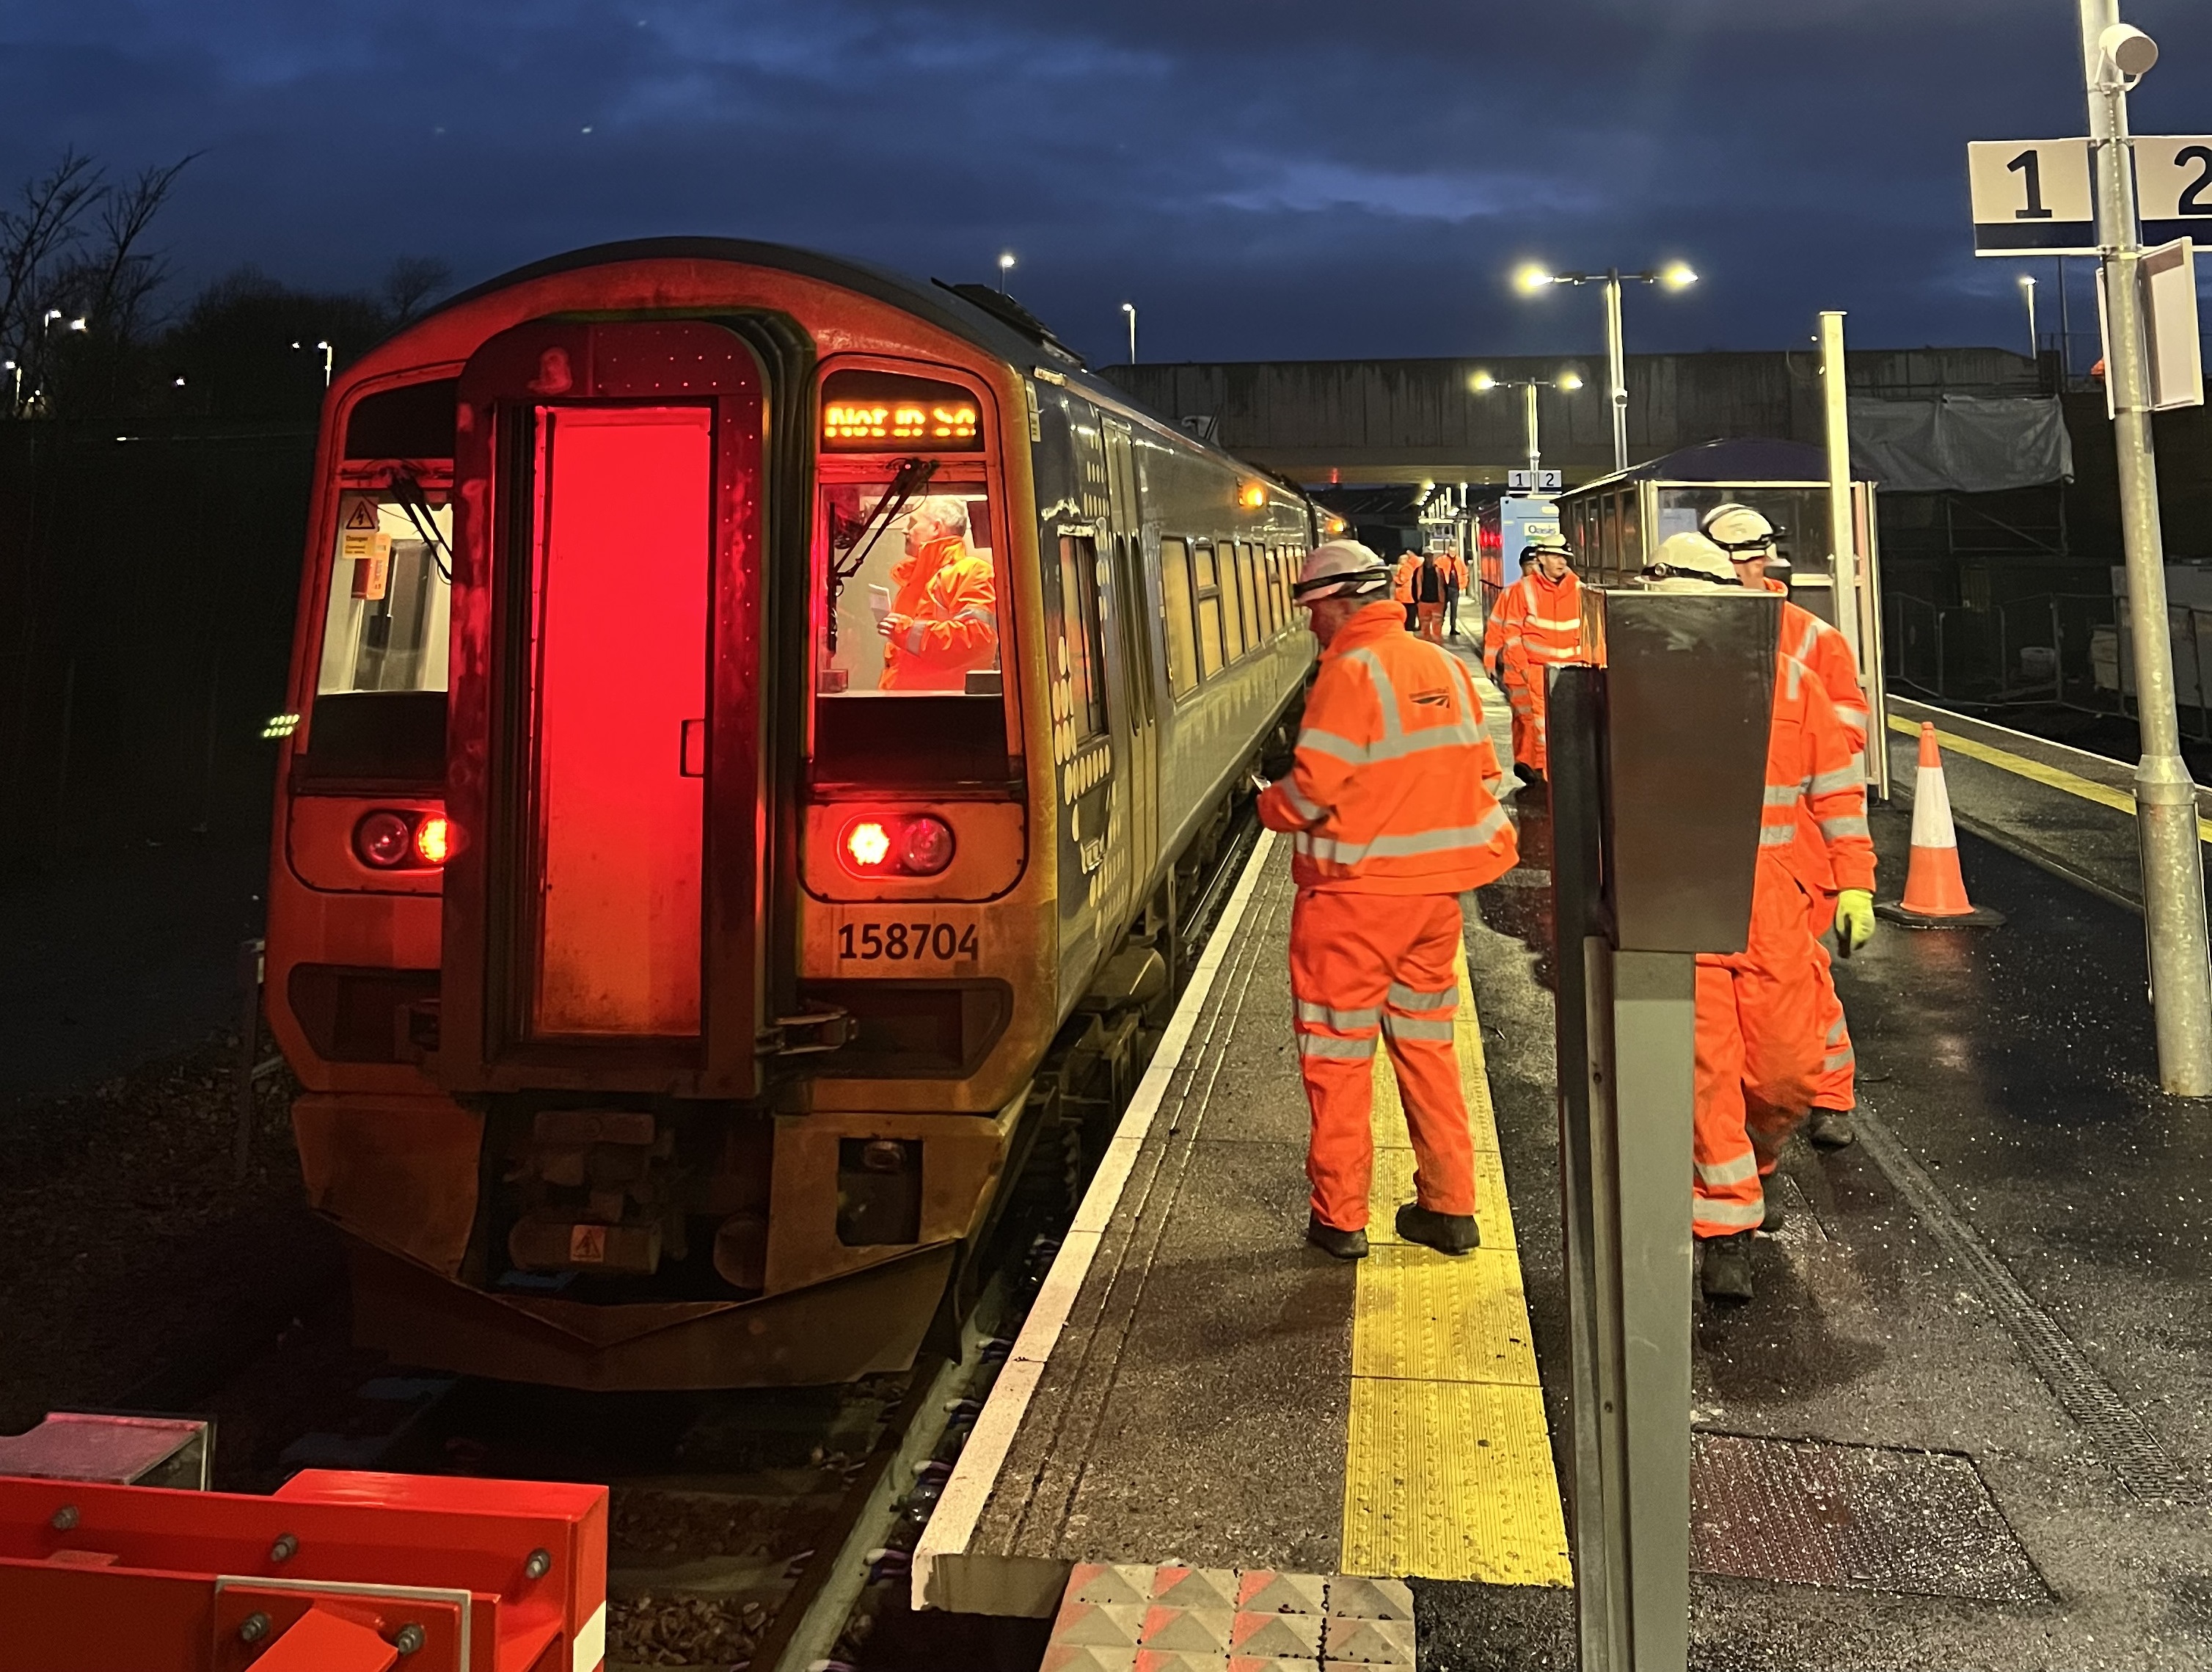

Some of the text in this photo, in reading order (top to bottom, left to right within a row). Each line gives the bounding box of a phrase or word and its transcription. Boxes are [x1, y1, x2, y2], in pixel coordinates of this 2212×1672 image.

[2007, 149, 2052, 219] 1
[2174, 145, 2212, 216] 2
[1515, 473, 1523, 486] 1
[1545, 472, 1554, 486] 2
[839, 923, 978, 960] 158704
